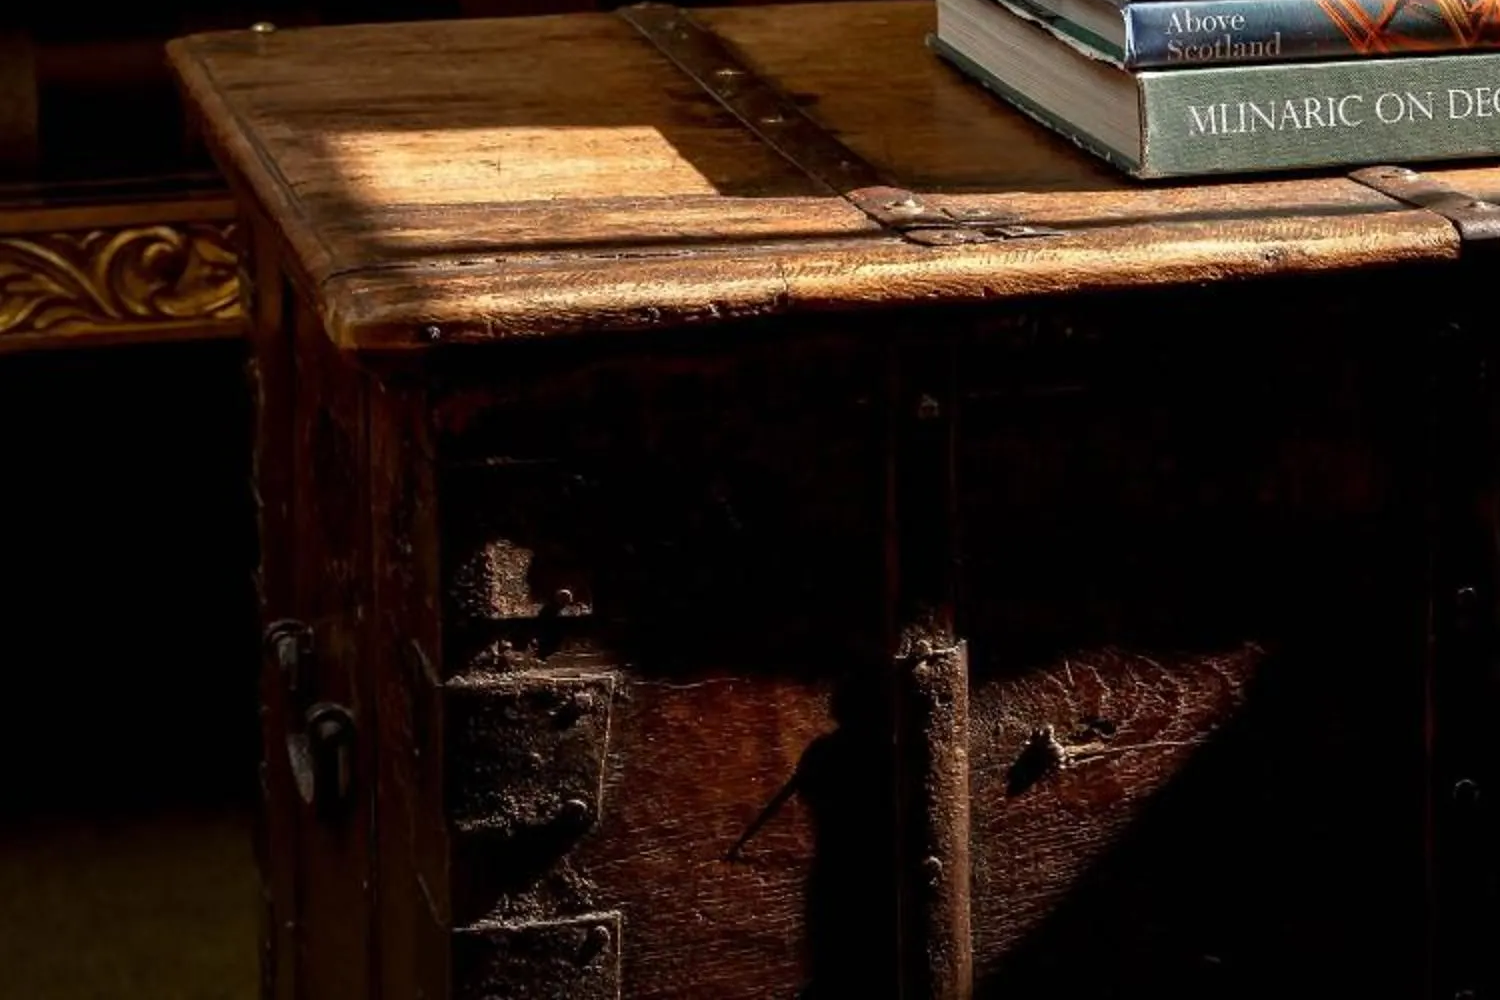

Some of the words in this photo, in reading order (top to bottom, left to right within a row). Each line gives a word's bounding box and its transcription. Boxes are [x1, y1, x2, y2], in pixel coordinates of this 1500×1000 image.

[1165, 10, 1246, 36] Above
[1166, 31, 1283, 61] Scotland
[1188, 94, 1365, 136] MLINARIC
[1374, 91, 1435, 124] ON
